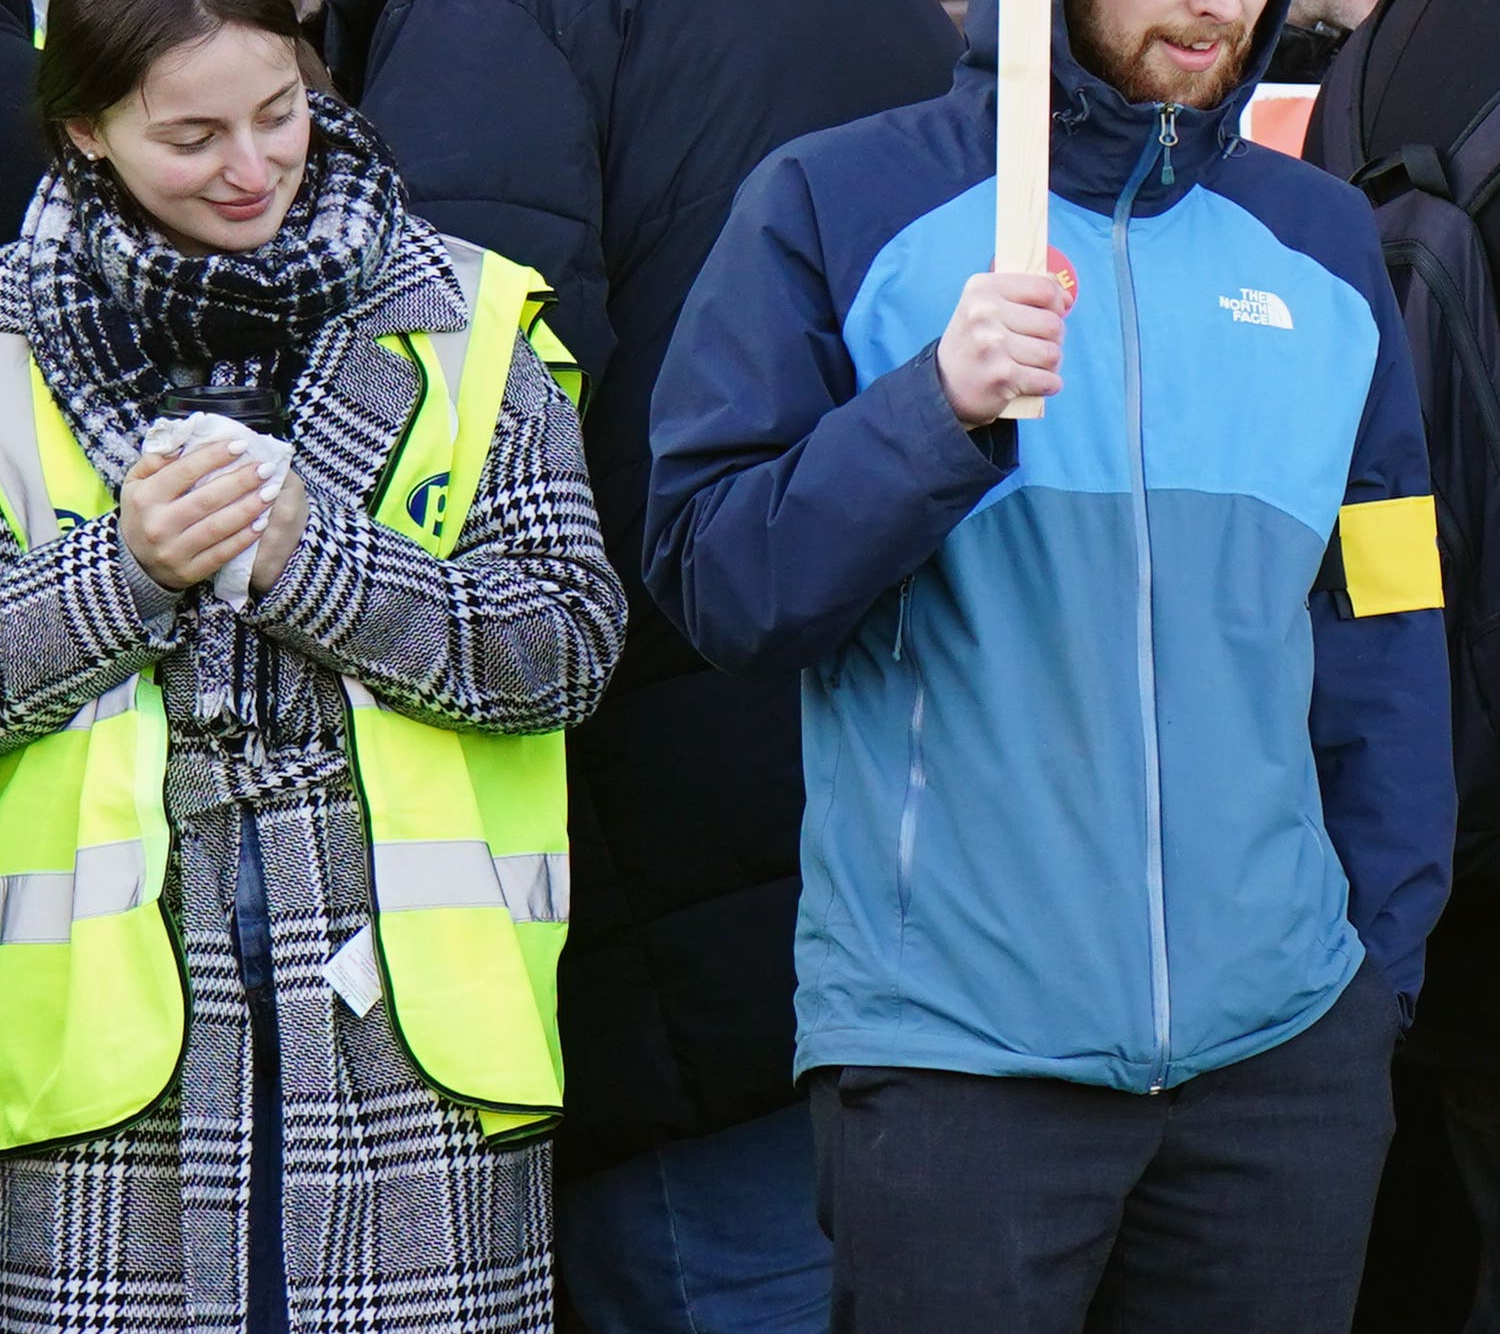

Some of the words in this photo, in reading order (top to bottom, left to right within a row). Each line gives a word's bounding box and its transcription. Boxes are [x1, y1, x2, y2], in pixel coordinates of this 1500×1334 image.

[1239, 287, 1269, 303] THE
[1218, 295, 1269, 315] NORTH
[1232, 310, 1269, 326] FACE
